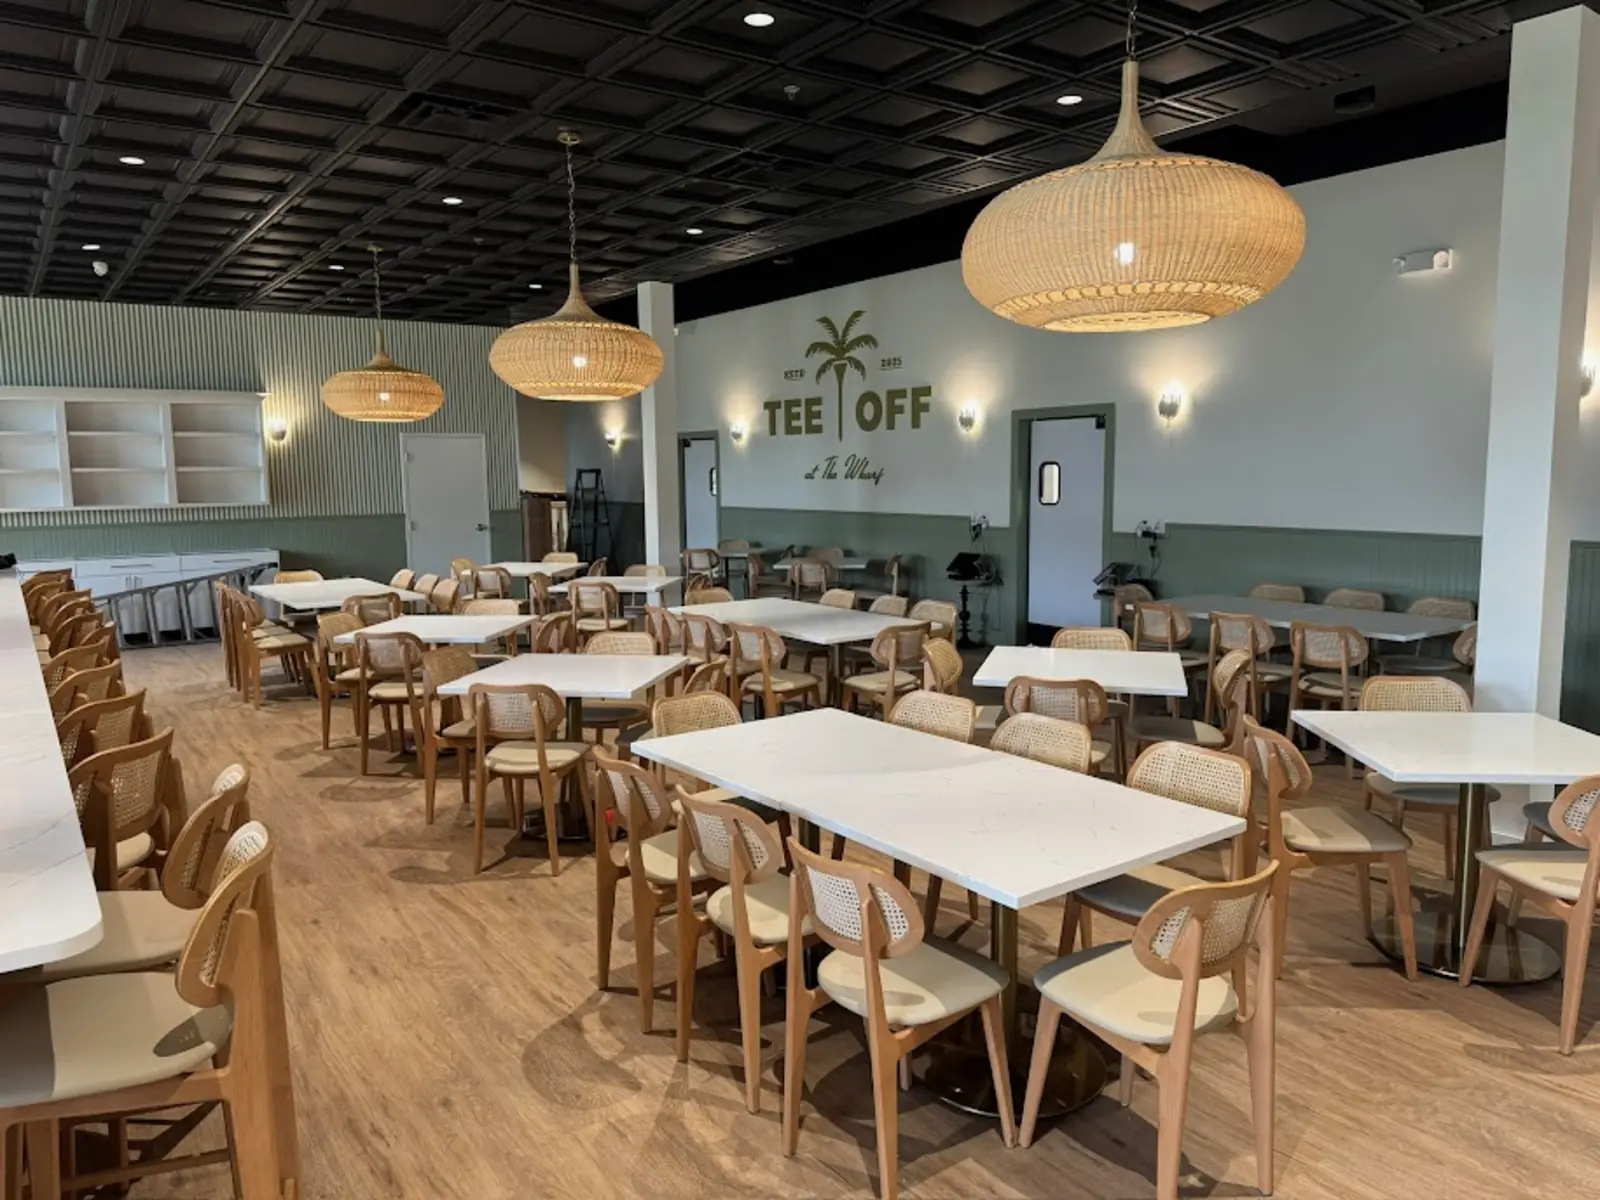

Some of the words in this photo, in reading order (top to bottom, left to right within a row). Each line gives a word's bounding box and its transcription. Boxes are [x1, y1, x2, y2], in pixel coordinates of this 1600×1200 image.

[763, 397, 823, 436] TEE
[855, 385, 932, 432] OFF
[804, 464, 819, 480] at
[822, 456, 839, 480] The
[844, 453, 885, 486] Wharf
